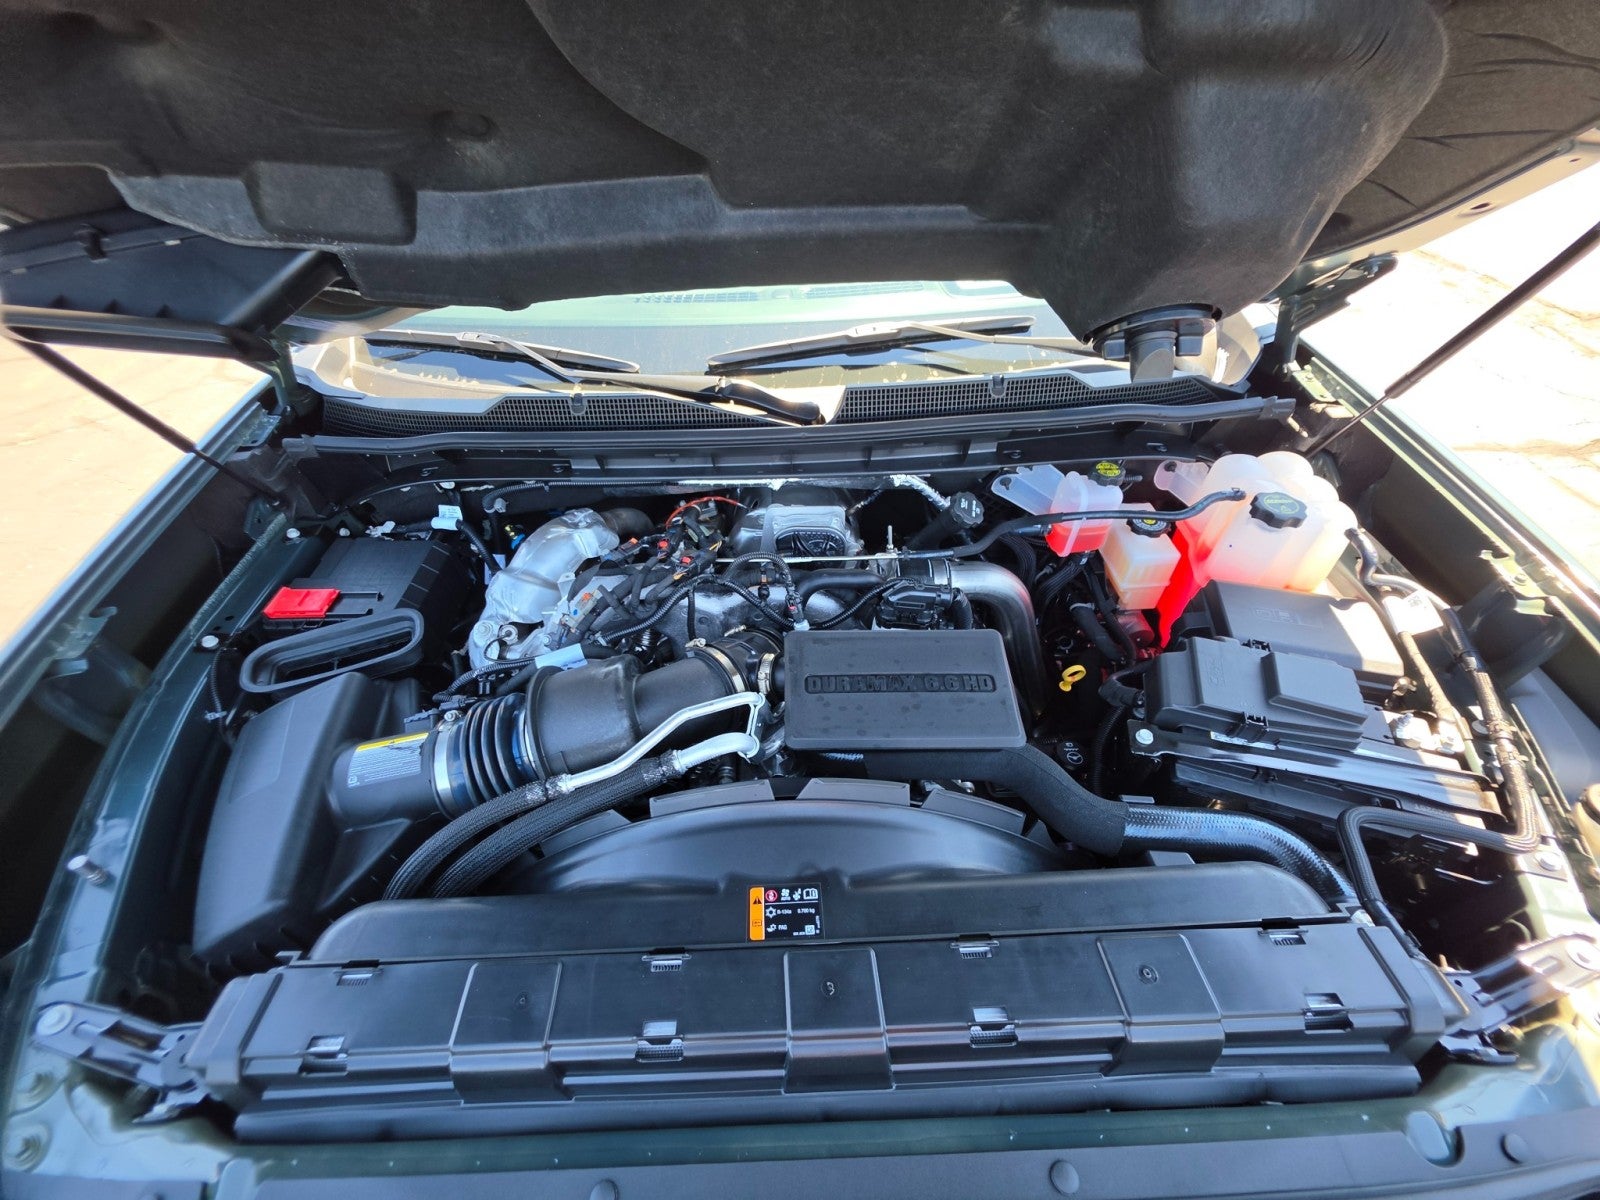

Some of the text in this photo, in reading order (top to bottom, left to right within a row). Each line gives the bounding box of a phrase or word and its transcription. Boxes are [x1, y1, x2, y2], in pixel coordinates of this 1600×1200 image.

[808, 675, 993, 692] DURAMAX 6.6 HD
